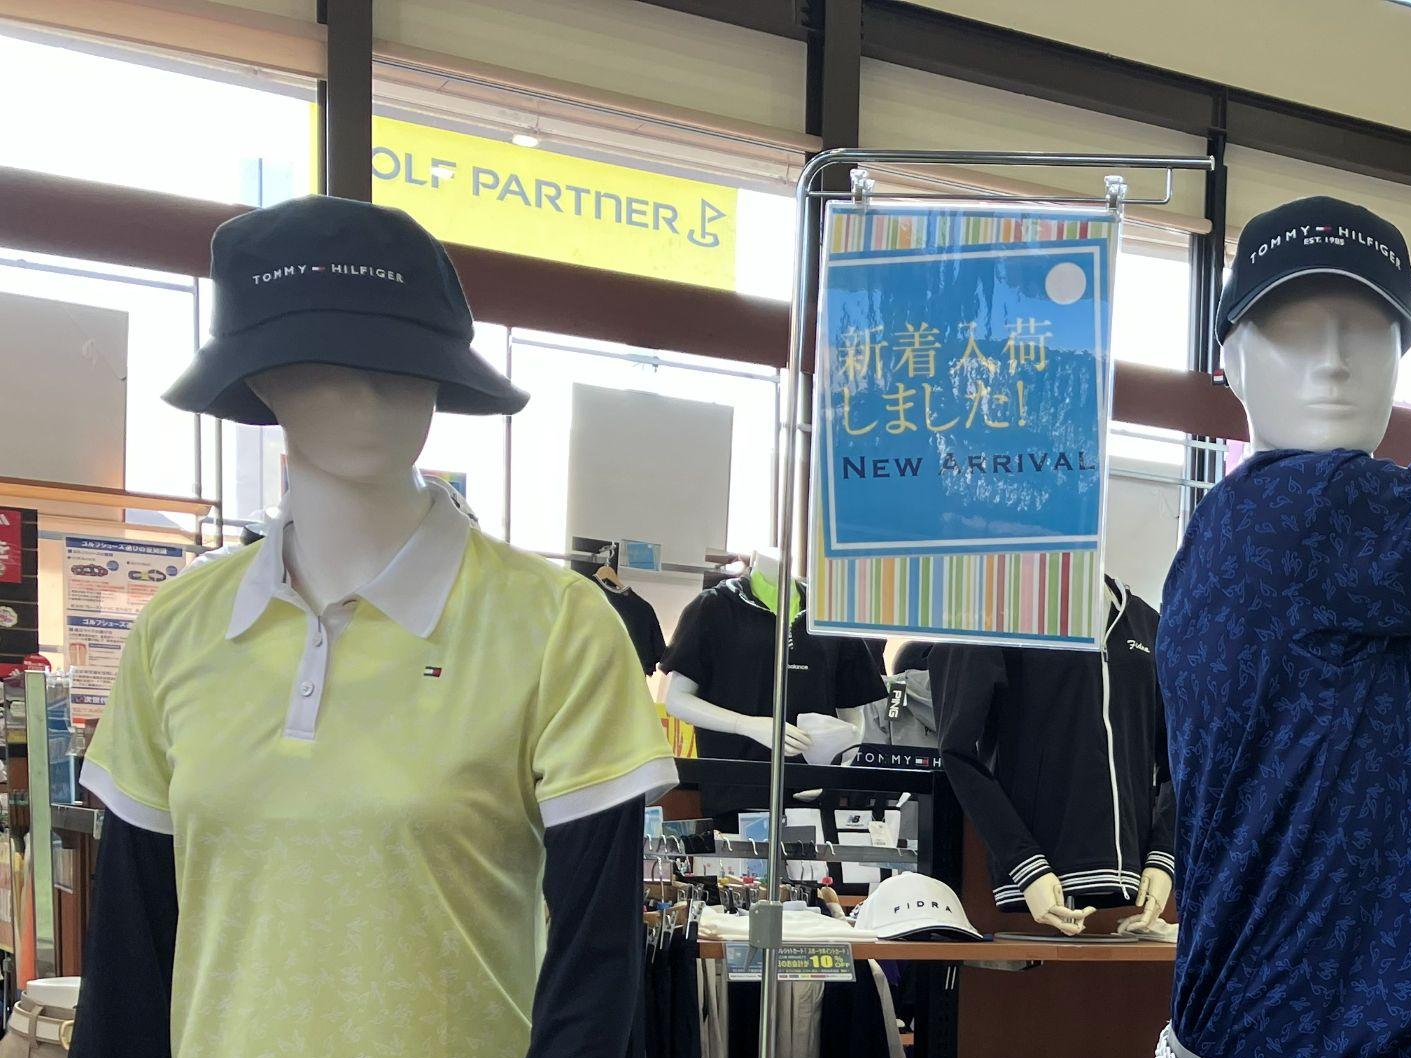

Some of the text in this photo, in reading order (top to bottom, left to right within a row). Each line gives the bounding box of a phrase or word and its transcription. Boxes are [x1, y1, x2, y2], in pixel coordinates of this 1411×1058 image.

[472, 165, 680, 235] PARTNER
[1249, 225, 1402, 271] TOMMY HILFIGER
[252, 263, 404, 285] TOMMY HILFIGER
[839, 317, 1053, 379] 新着入荷
[842, 380, 1029, 437] しました!
[888, 689, 904, 719] PING
[855, 751, 912, 766] TOMMY
[893, 900, 953, 914] FIDRA
[810, 954, 833, 968] 10
